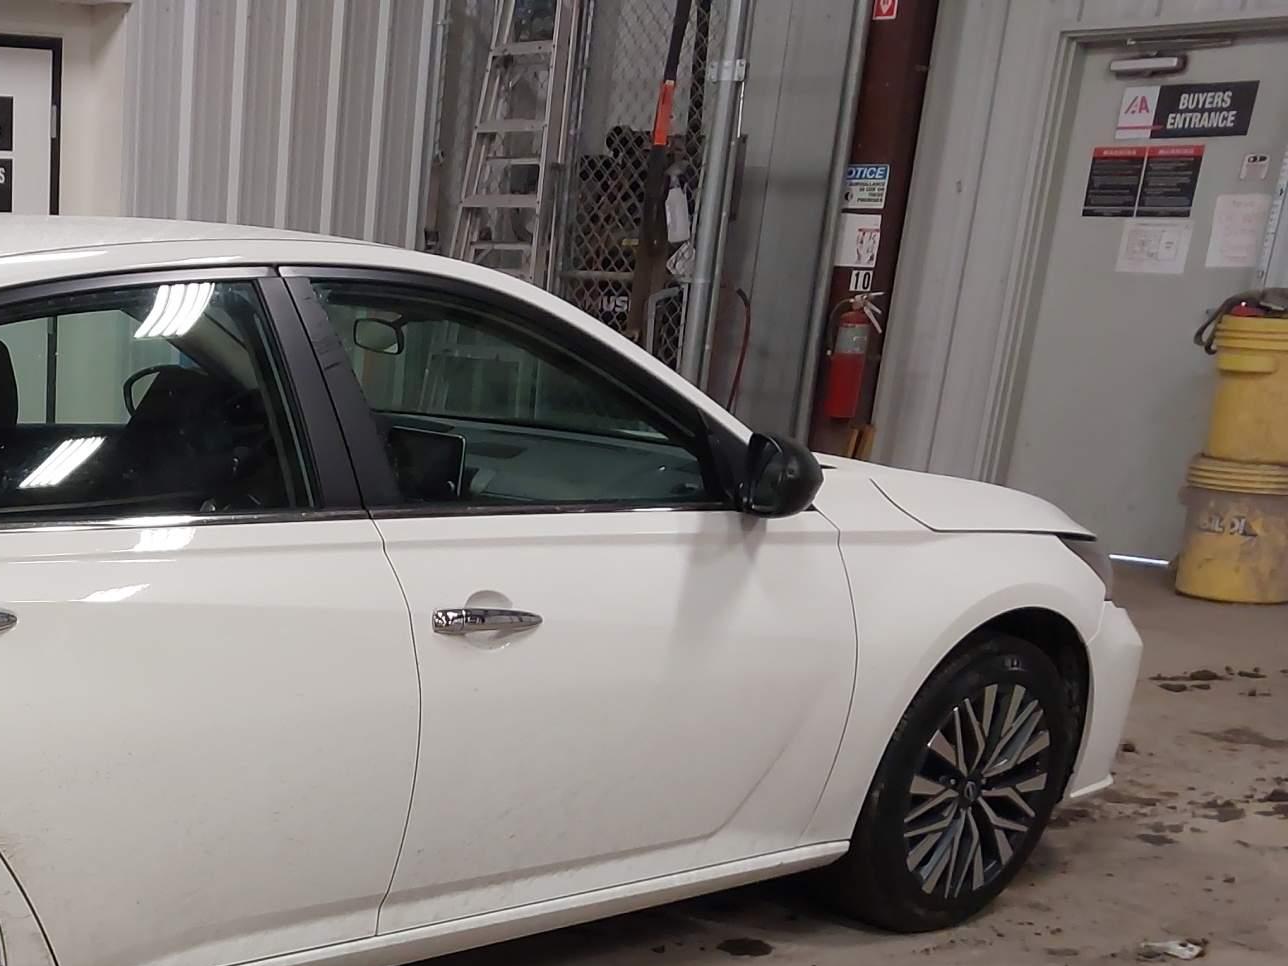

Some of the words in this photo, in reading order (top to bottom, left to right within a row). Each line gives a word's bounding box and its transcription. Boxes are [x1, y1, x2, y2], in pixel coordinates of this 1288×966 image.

[1178, 91, 1233, 110] BUYERS
[1165, 111, 1238, 129] ENTRANCE
[847, 167, 886, 179] OTICE
[854, 271, 871, 290] 10
